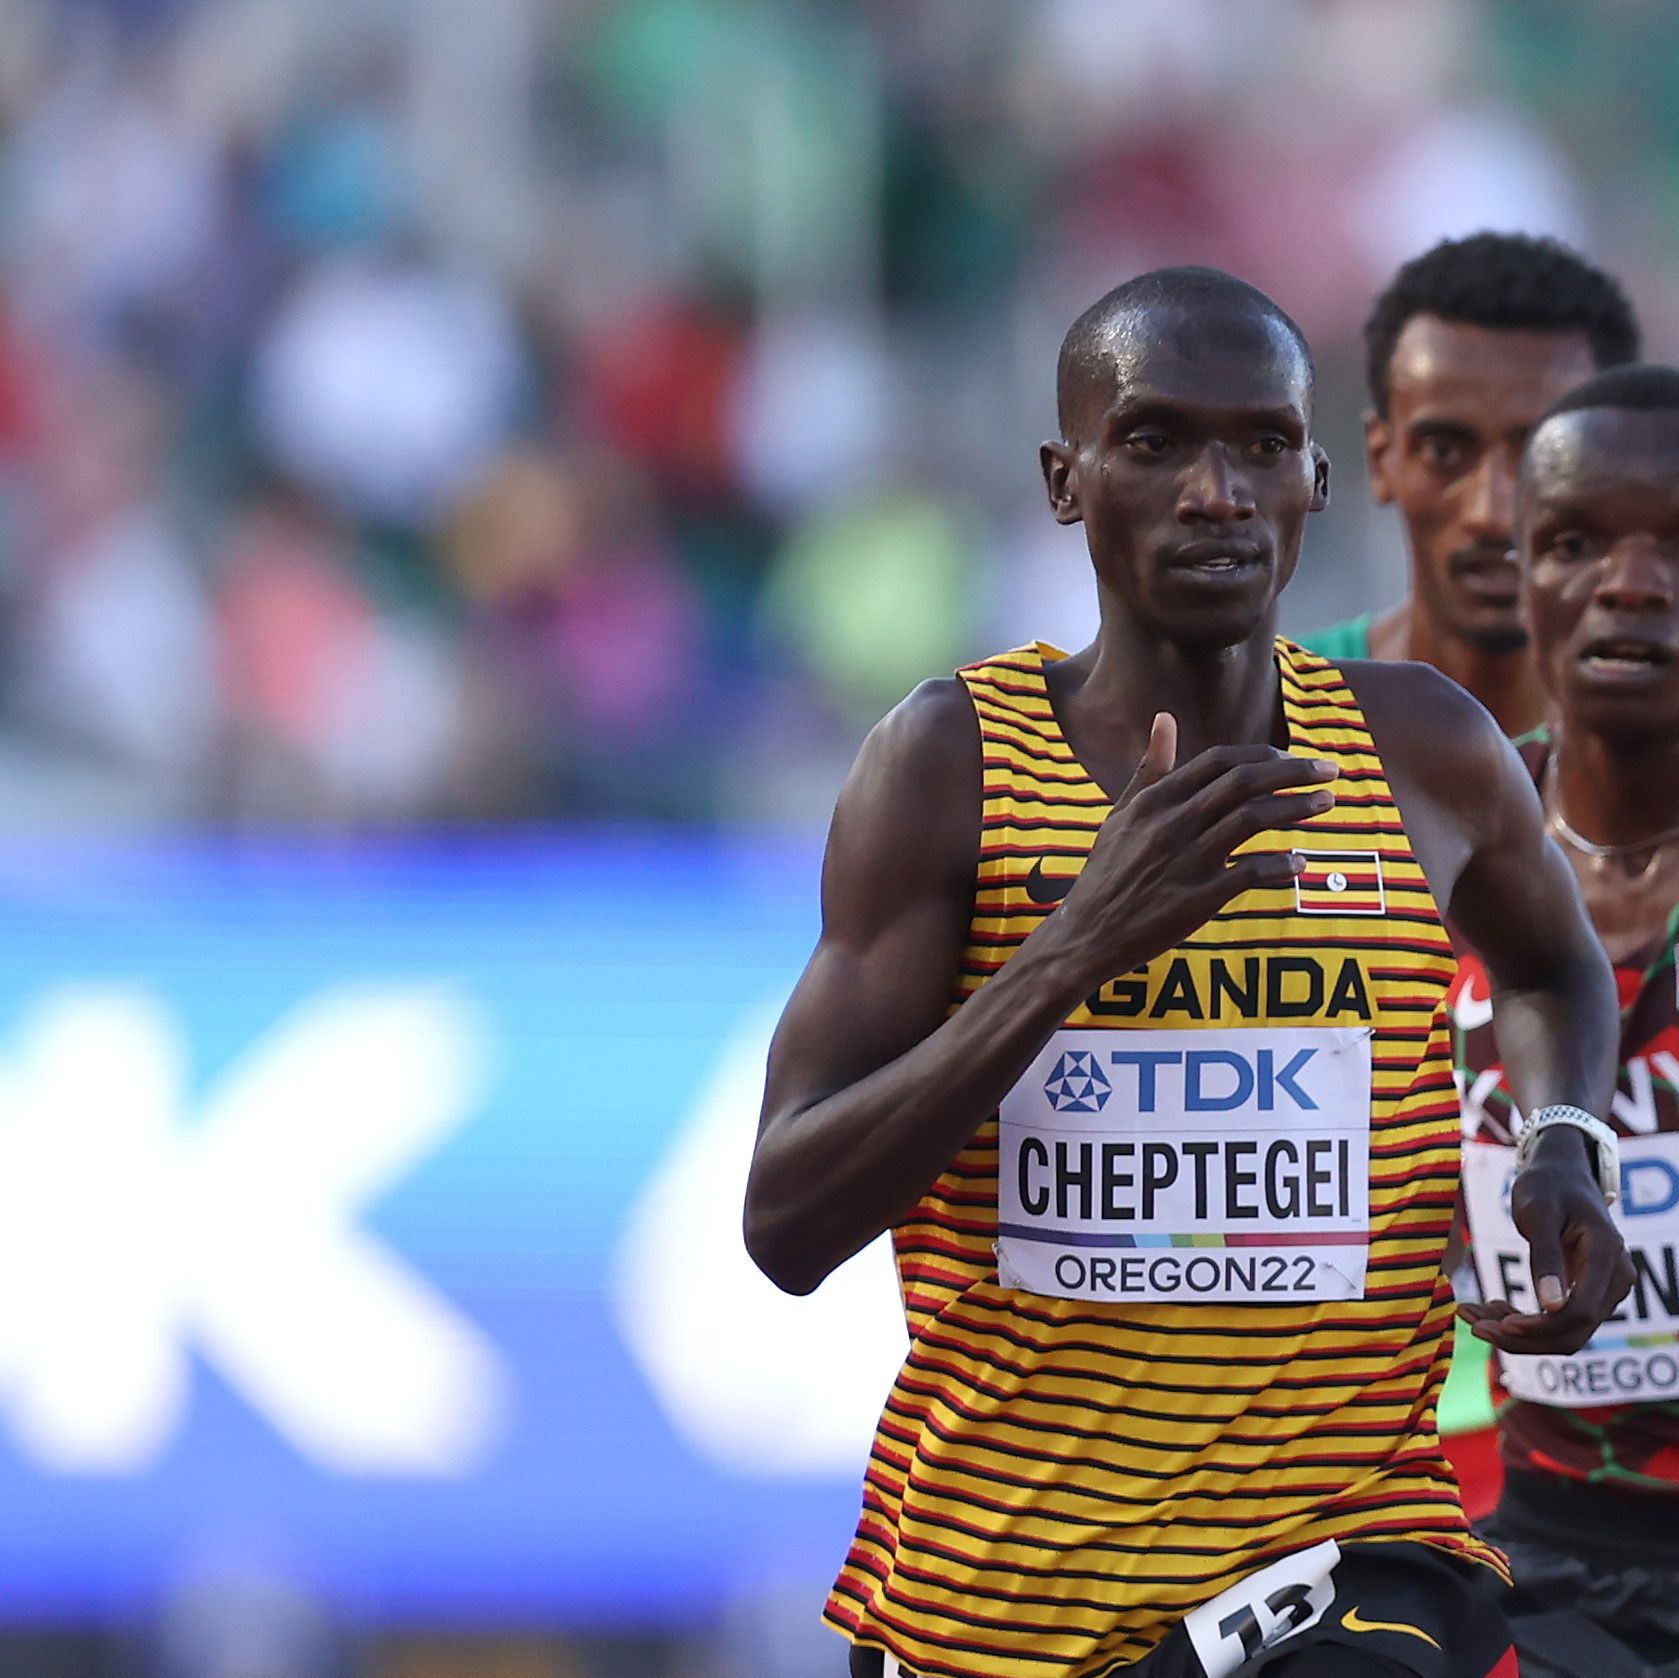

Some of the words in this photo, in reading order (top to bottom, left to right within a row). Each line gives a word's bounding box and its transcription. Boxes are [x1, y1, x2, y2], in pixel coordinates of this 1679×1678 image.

[1086, 957, 1373, 1020] GANDA
[1111, 1048, 1320, 1112] TDK
[1017, 1136, 1350, 1220] CHEPTEGEI
[1055, 1254, 1316, 1292] OREGON22
